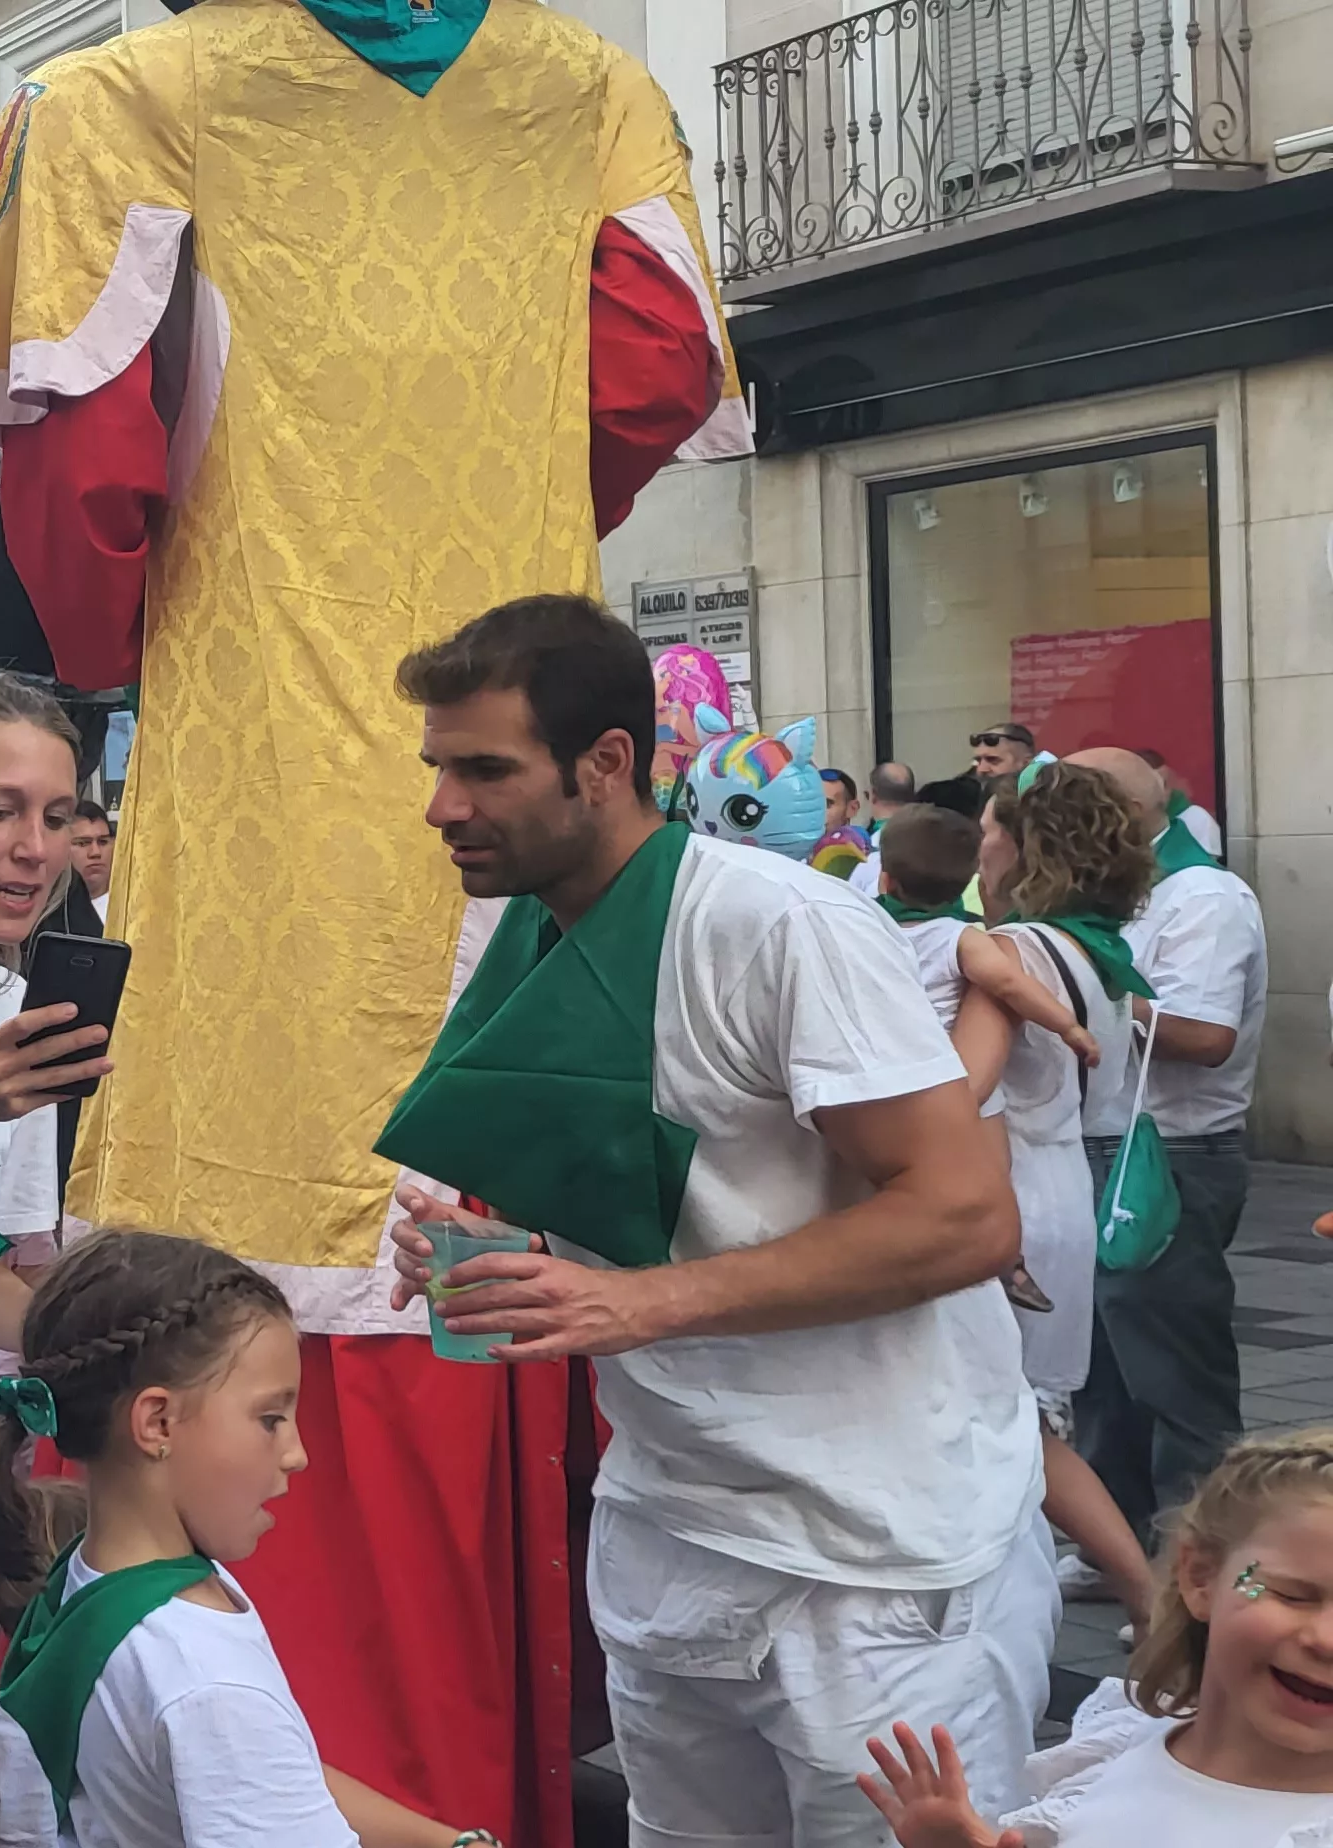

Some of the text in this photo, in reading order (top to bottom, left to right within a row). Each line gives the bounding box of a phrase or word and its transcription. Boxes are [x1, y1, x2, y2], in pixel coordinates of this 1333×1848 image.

[639, 592, 686, 615] ALQUILO
[701, 634, 742, 645] Y LOFT
